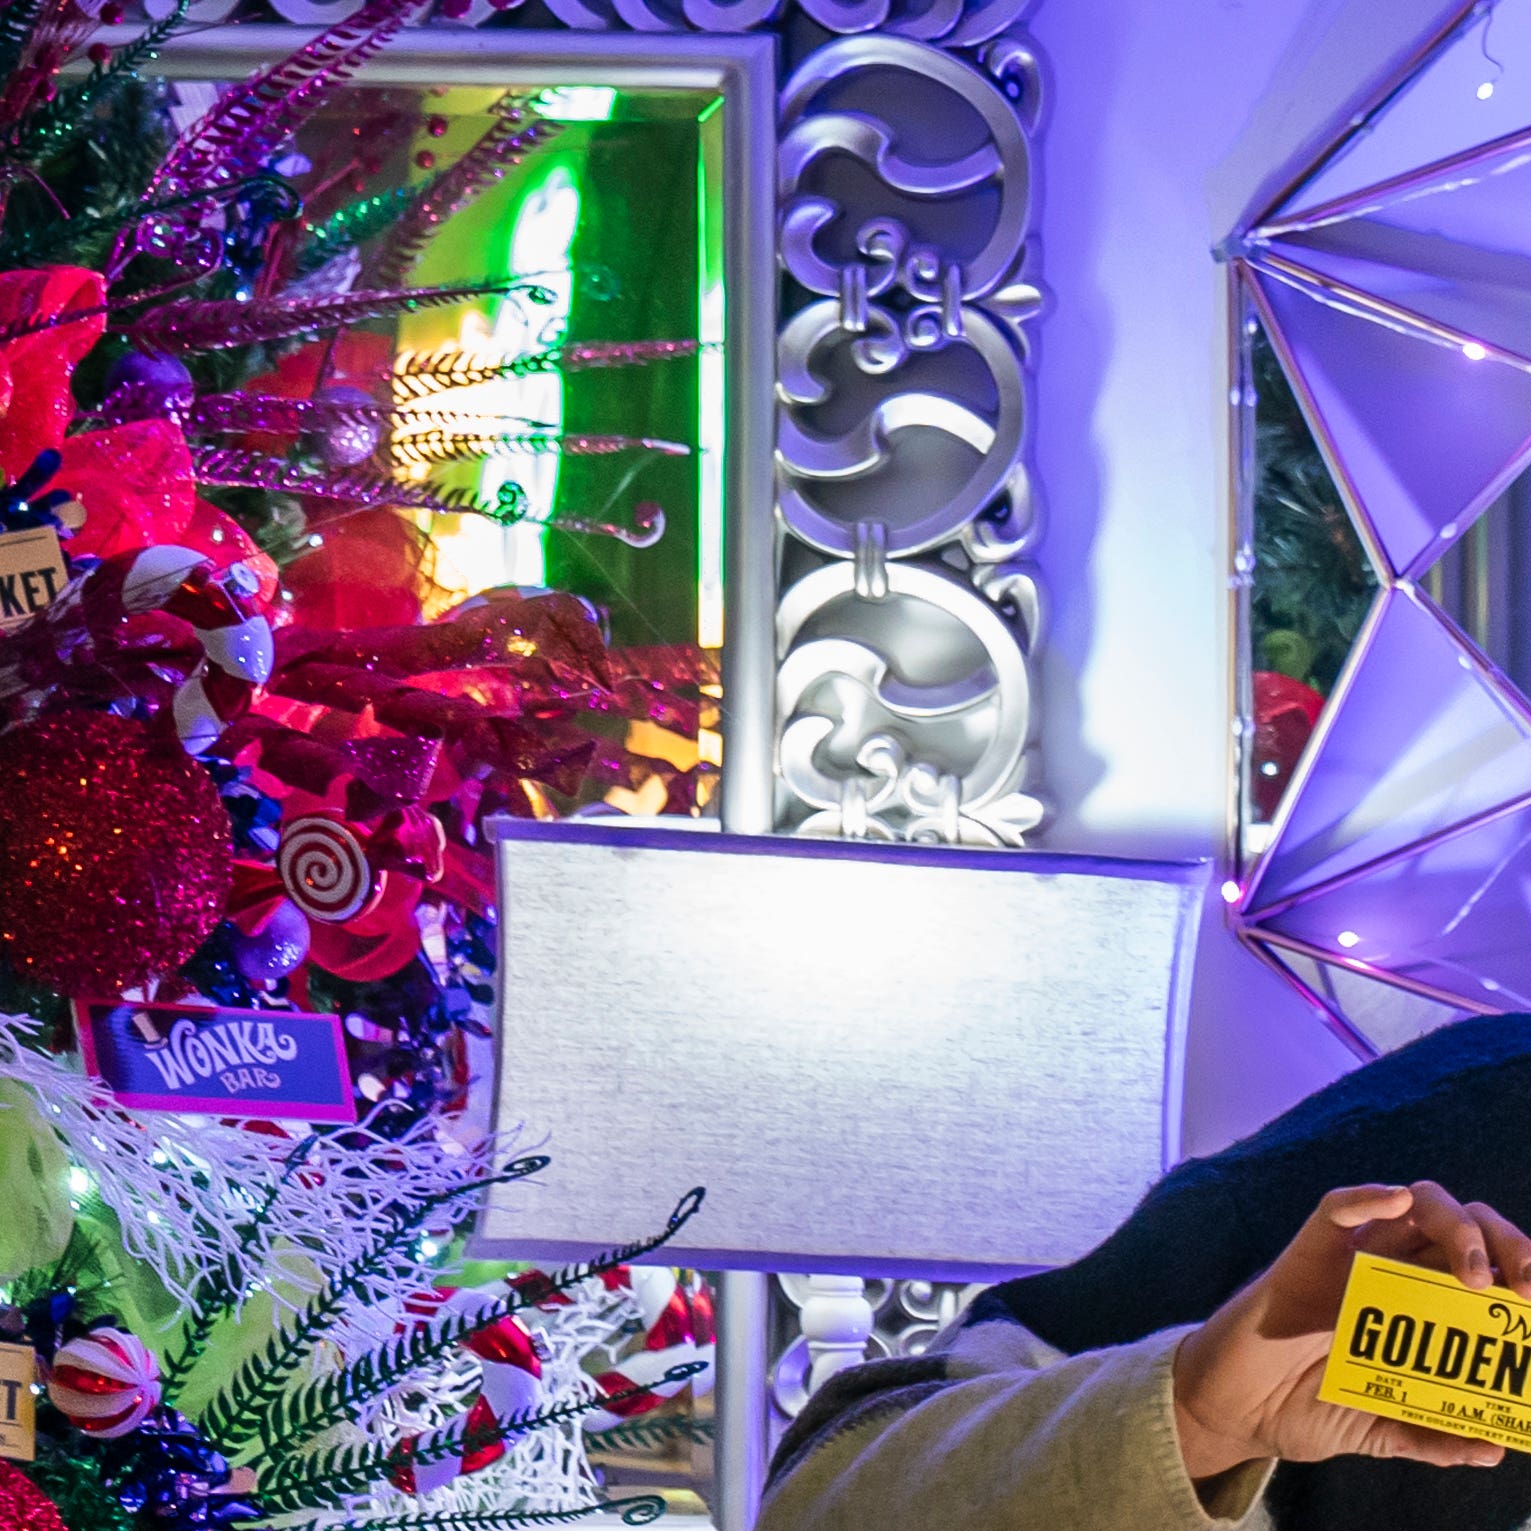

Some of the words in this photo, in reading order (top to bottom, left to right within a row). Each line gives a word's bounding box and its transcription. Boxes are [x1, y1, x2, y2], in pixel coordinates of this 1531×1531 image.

[0, 566, 56, 618] KET
[144, 1018, 297, 1089] WONKA
[219, 1067, 281, 1094] BAR
[1401, 1391, 1408, 1403] 1
[1440, 1400, 1455, 1414] 10
[1458, 1404, 1487, 1422] A.M.
